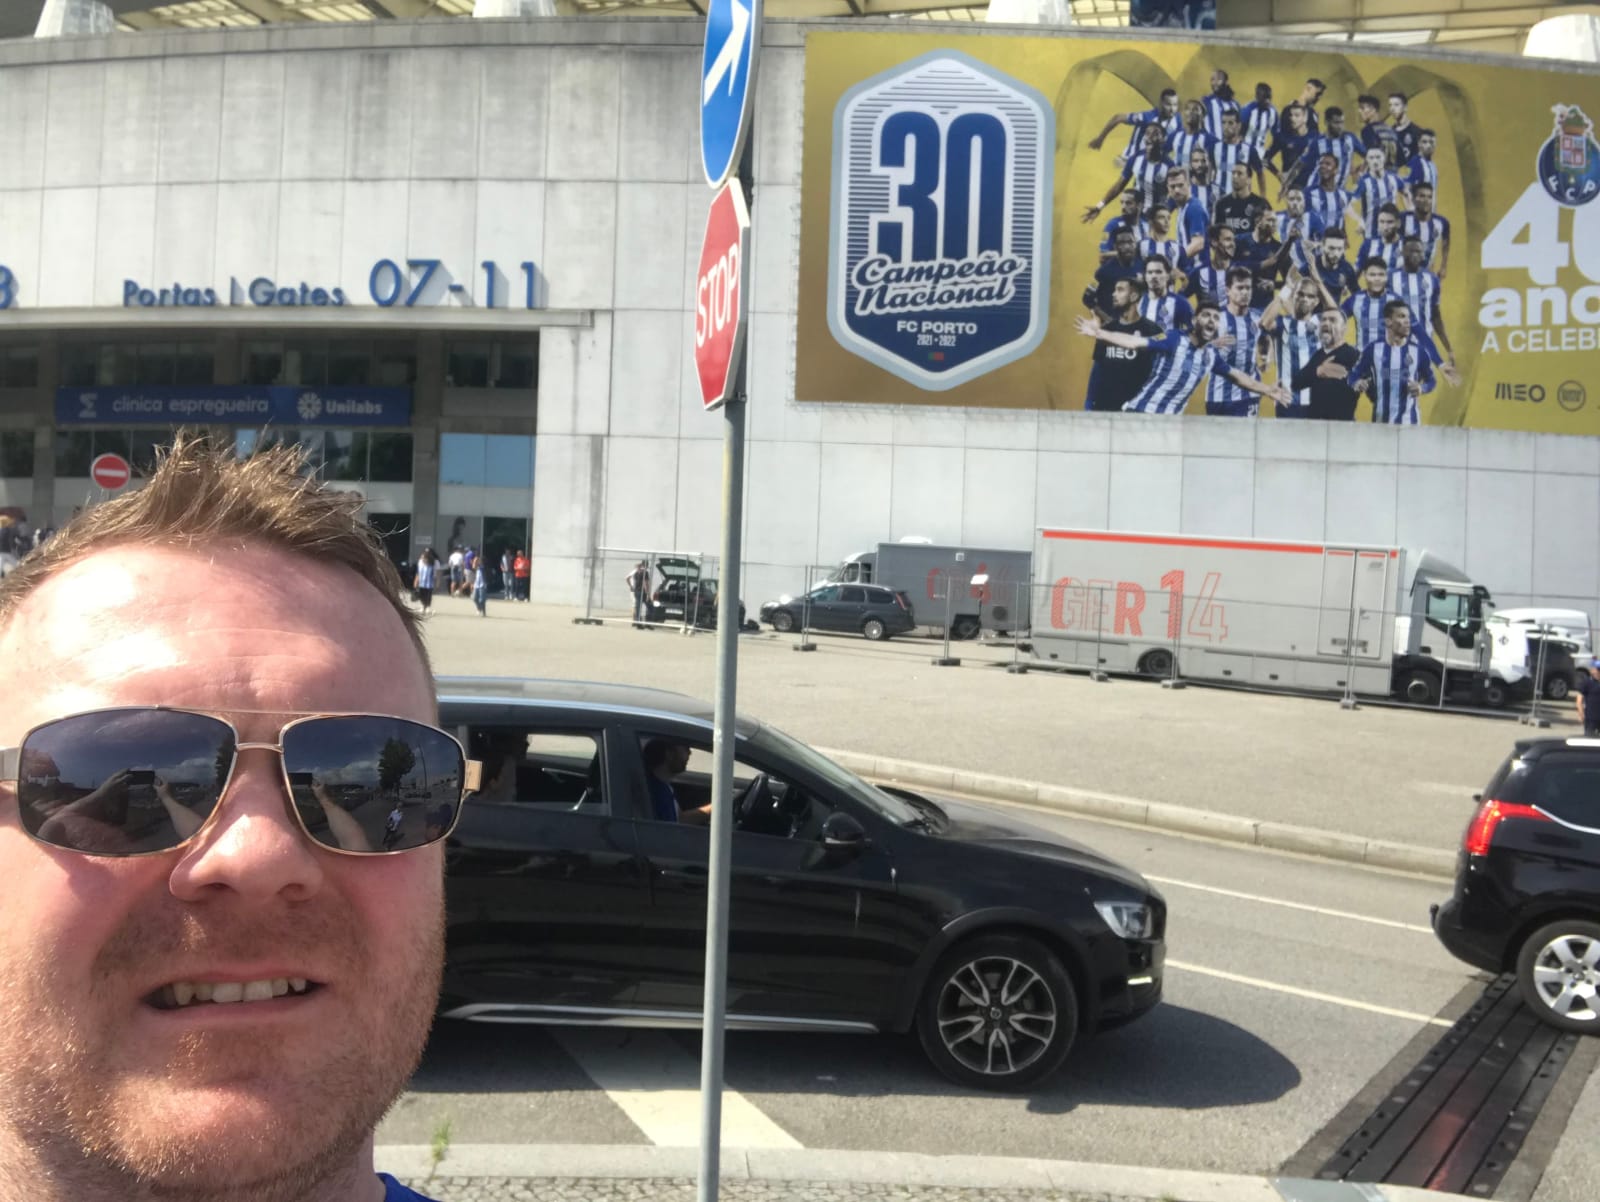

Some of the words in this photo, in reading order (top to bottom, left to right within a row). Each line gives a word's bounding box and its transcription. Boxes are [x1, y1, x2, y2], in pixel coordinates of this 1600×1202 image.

[878, 111, 1007, 263] 30
[855, 251, 1022, 288] Campeão
[123, 278, 217, 307] Portas
[248, 277, 346, 307] Gates
[696, 242, 738, 348] STOP
[858, 277, 1014, 312] Nacional
[896, 320, 918, 332] FC
[920, 320, 978, 335] PORTO
[1481, 330, 1500, 353] A
[1507, 327, 1600, 353] CELEB
[168, 396, 269, 417] espregueira
[325, 399, 383, 415] Unilabs
[1160, 569, 1229, 643] 14
